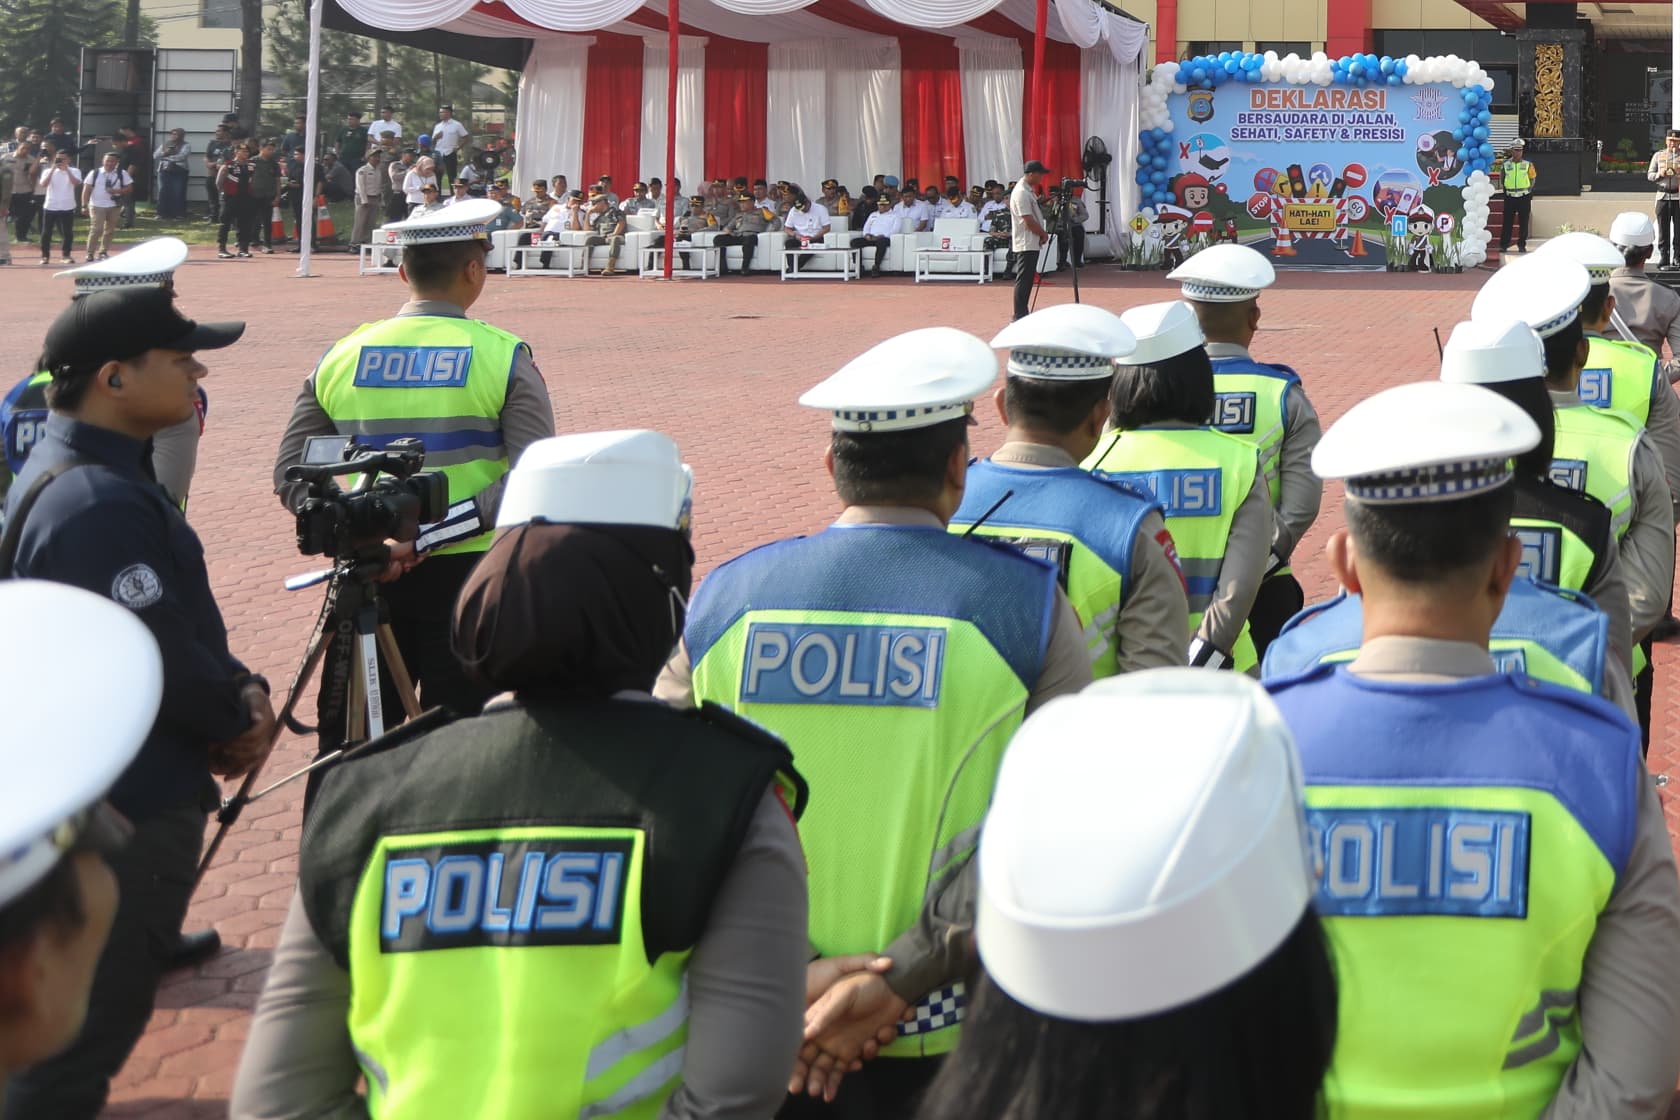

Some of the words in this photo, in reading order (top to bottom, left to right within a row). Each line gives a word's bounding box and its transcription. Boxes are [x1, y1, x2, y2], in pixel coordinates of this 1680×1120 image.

[1251, 89, 1386, 109] DEKLARASI
[1238, 113, 1329, 124] BERSAUDARA
[1332, 114, 1345, 124] DI
[1347, 114, 1397, 126] JALAN,
[1231, 127, 1281, 140] SEHATI,
[1284, 128, 1336, 139] SAFETY
[1340, 128, 1350, 140] &
[1354, 128, 1404, 140] PRESISI
[1251, 196, 1269, 215] STOP
[1289, 210, 1331, 218] HATI-HATI
[1351, 201, 1363, 214] 60
[360, 351, 467, 381] POLISI
[367, 657, 379, 686] SLIK
[747, 631, 940, 699] POLISI
[1313, 822, 1516, 901] OLISI
[382, 851, 624, 940] POLISI
